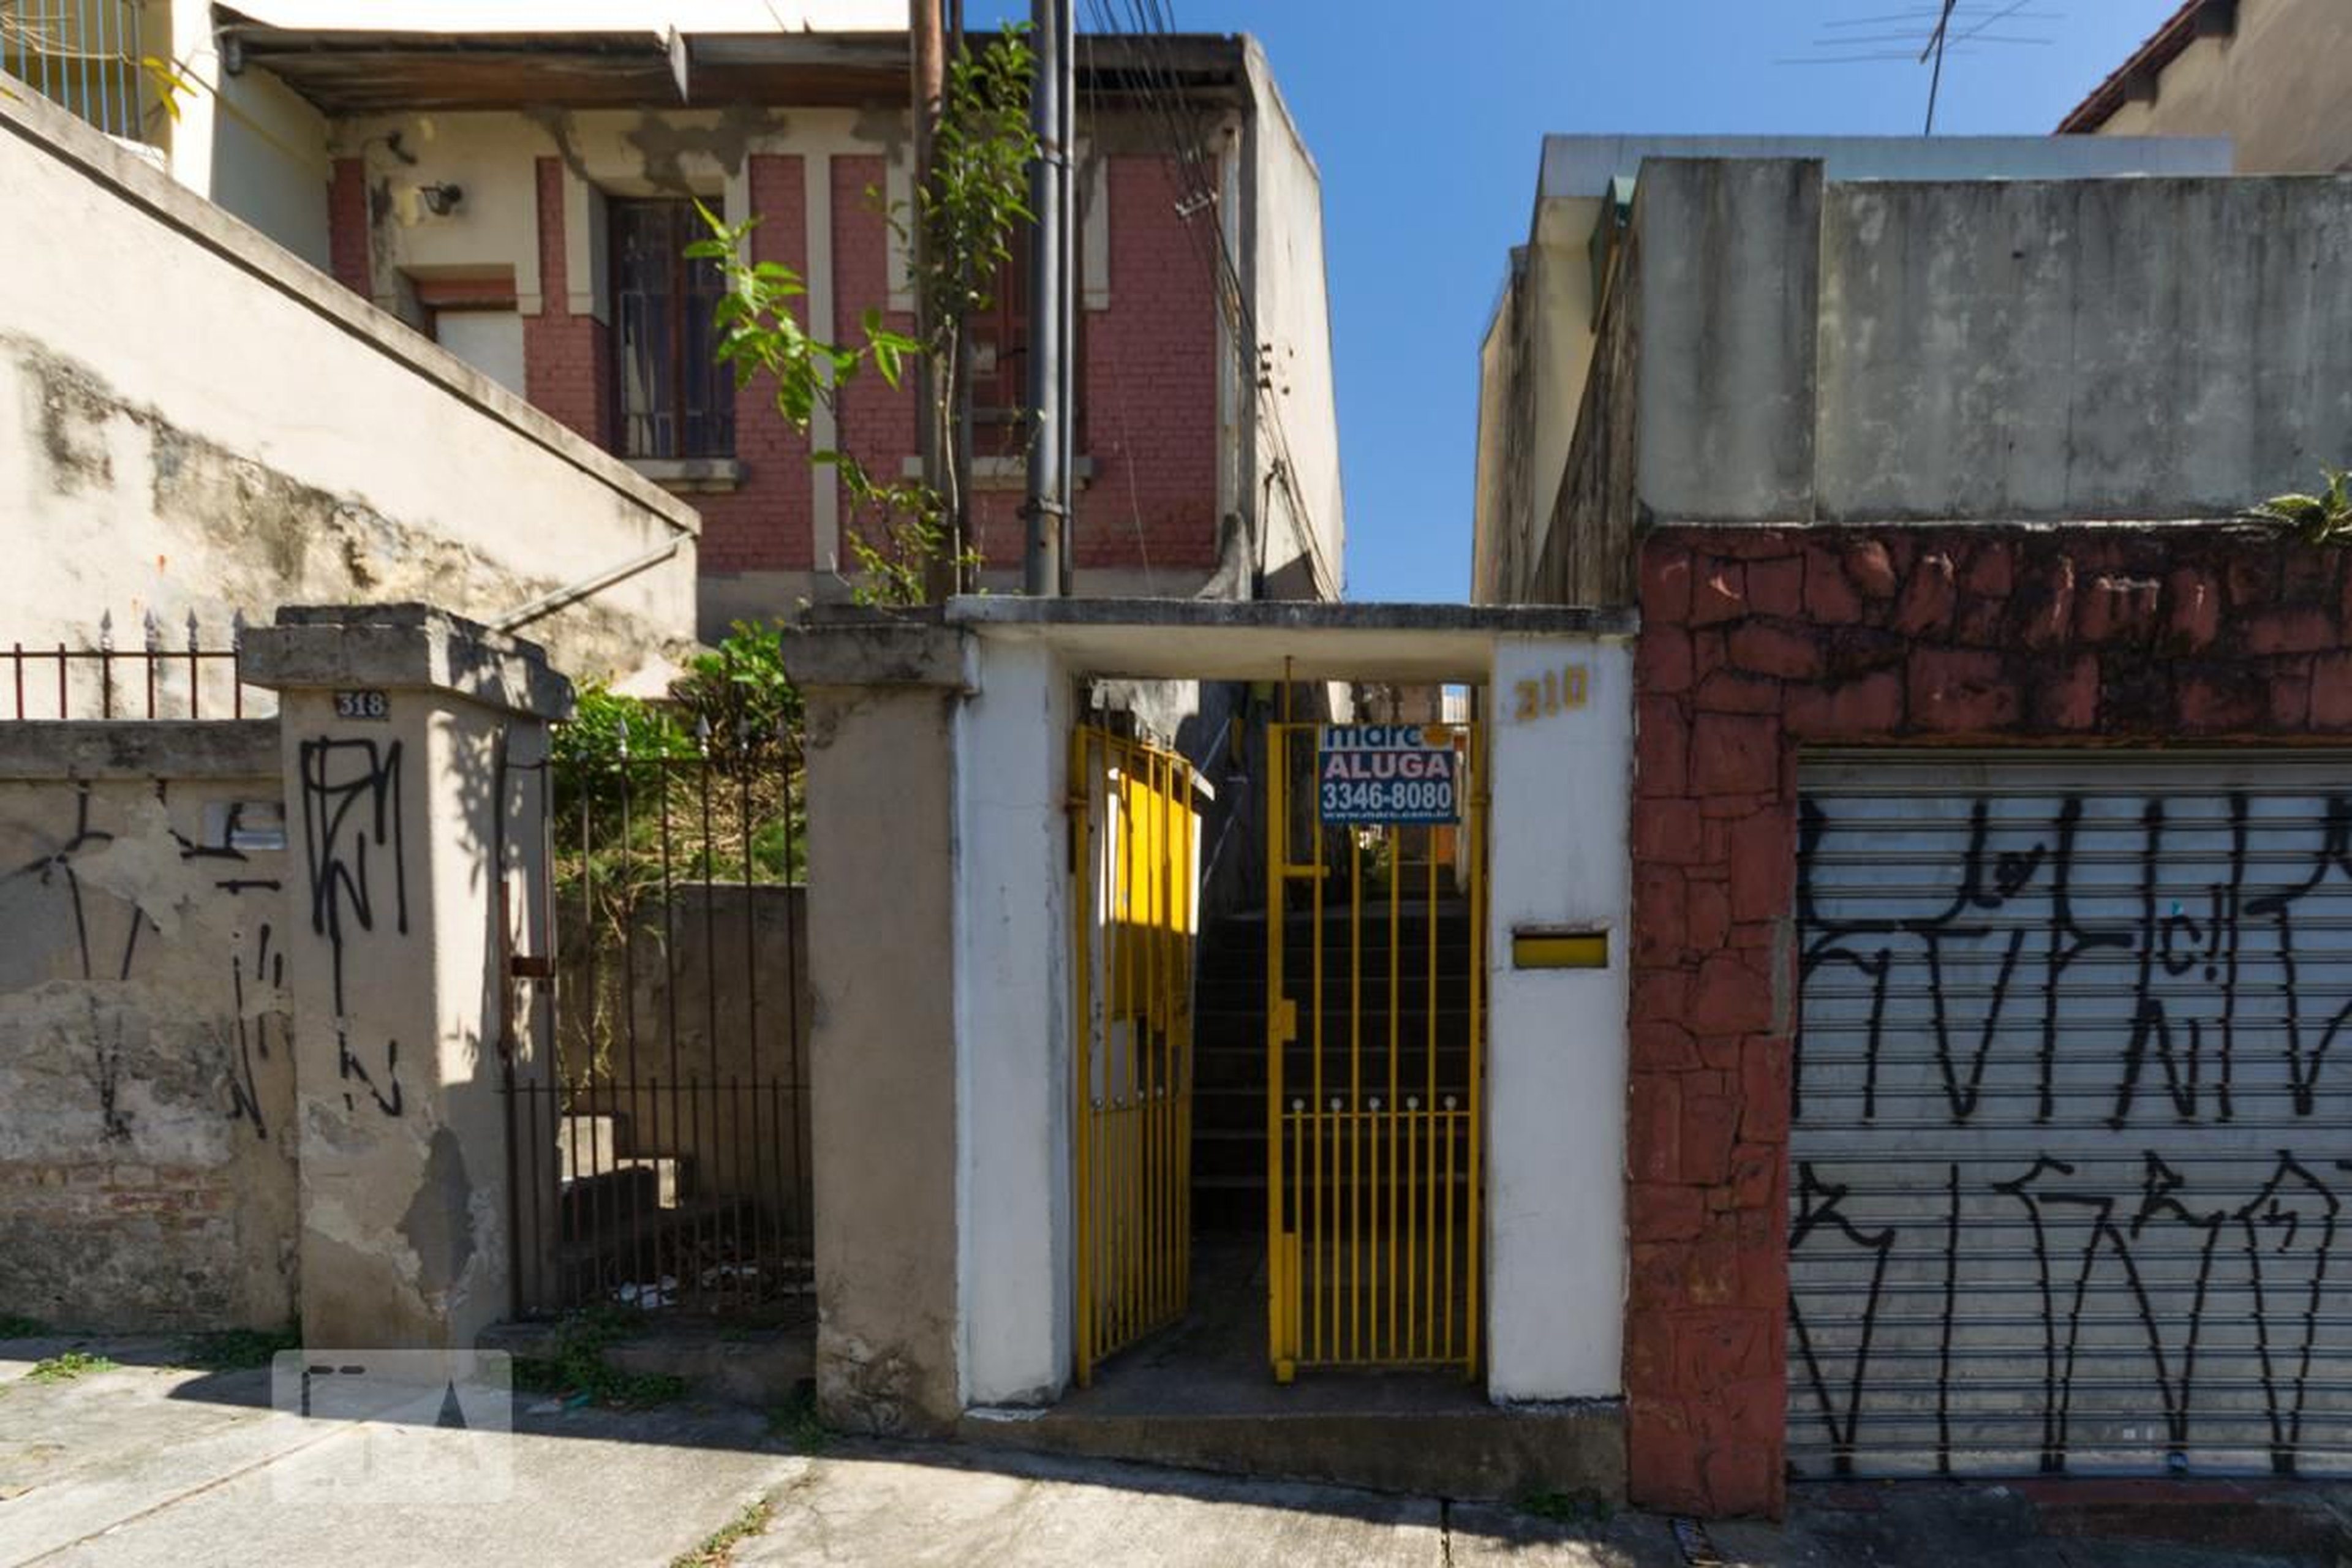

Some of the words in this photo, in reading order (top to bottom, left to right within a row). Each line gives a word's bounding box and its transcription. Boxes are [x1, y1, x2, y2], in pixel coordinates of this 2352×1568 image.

[339, 692, 384, 716] 318
[1325, 753, 1450, 778] ALUGA
[1322, 782, 1452, 809] 3346-8080
